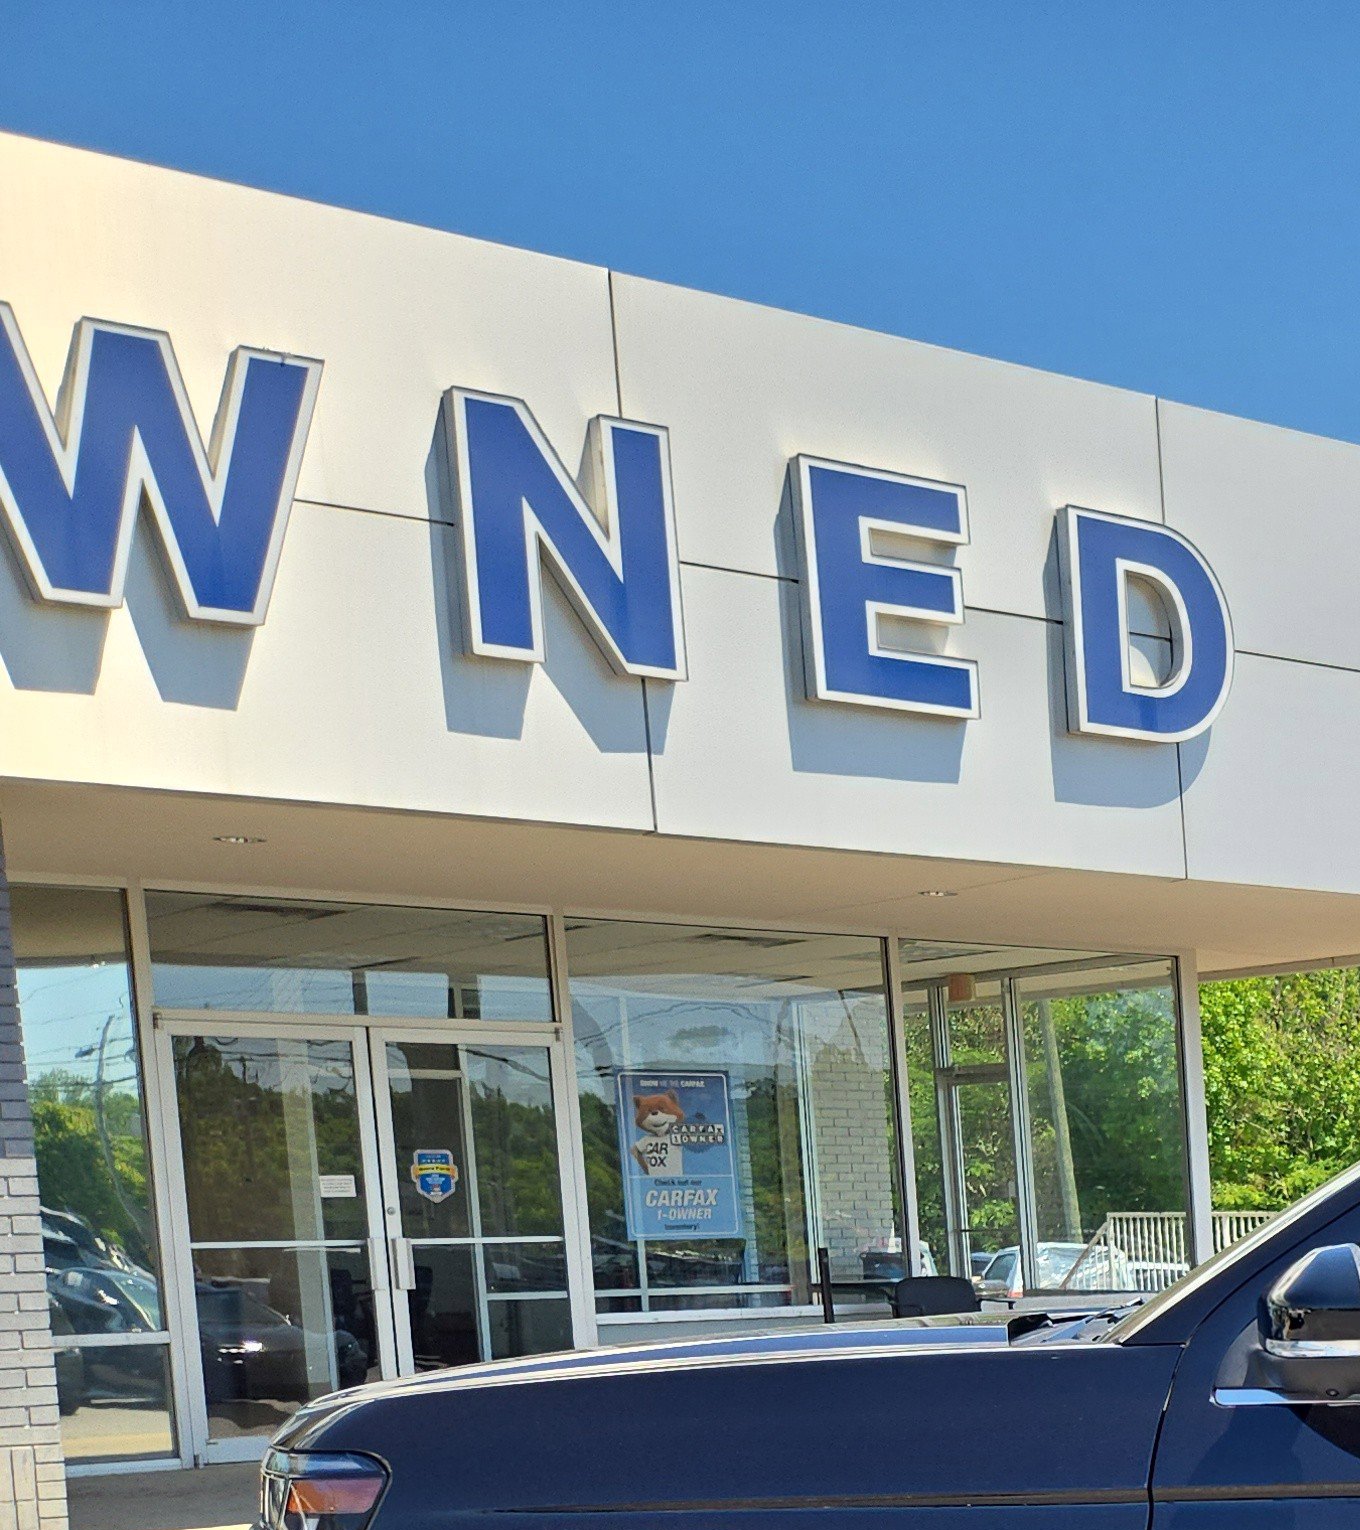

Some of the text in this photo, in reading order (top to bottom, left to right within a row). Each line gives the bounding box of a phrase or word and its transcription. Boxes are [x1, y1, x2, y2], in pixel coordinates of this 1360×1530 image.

[647, 1156, 667, 1167] OX
[646, 1189, 719, 1207] CARFAX
[657, 1208, 712, 1220] 1-OWNER
